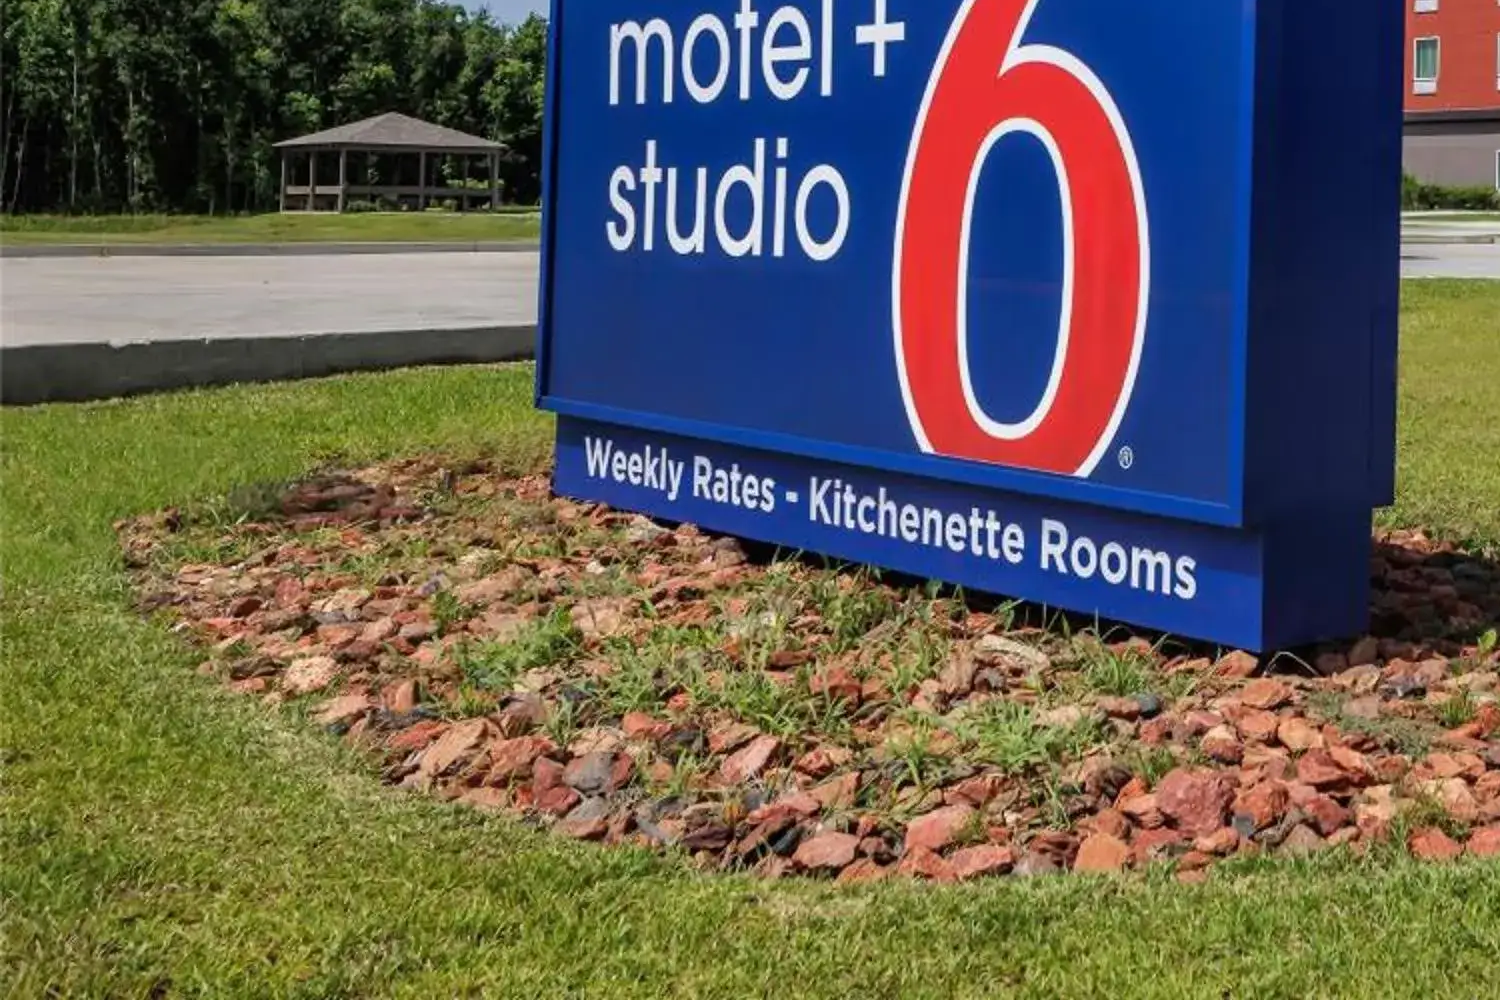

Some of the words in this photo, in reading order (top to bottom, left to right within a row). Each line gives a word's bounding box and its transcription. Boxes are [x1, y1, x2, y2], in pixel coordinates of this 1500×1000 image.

[606, 137, 850, 261] studio
[585, 436, 685, 501] Weekly
[693, 455, 776, 513] Rates
[809, 475, 1025, 564] Kitchenette
[1040, 518, 1197, 600] Rooms
